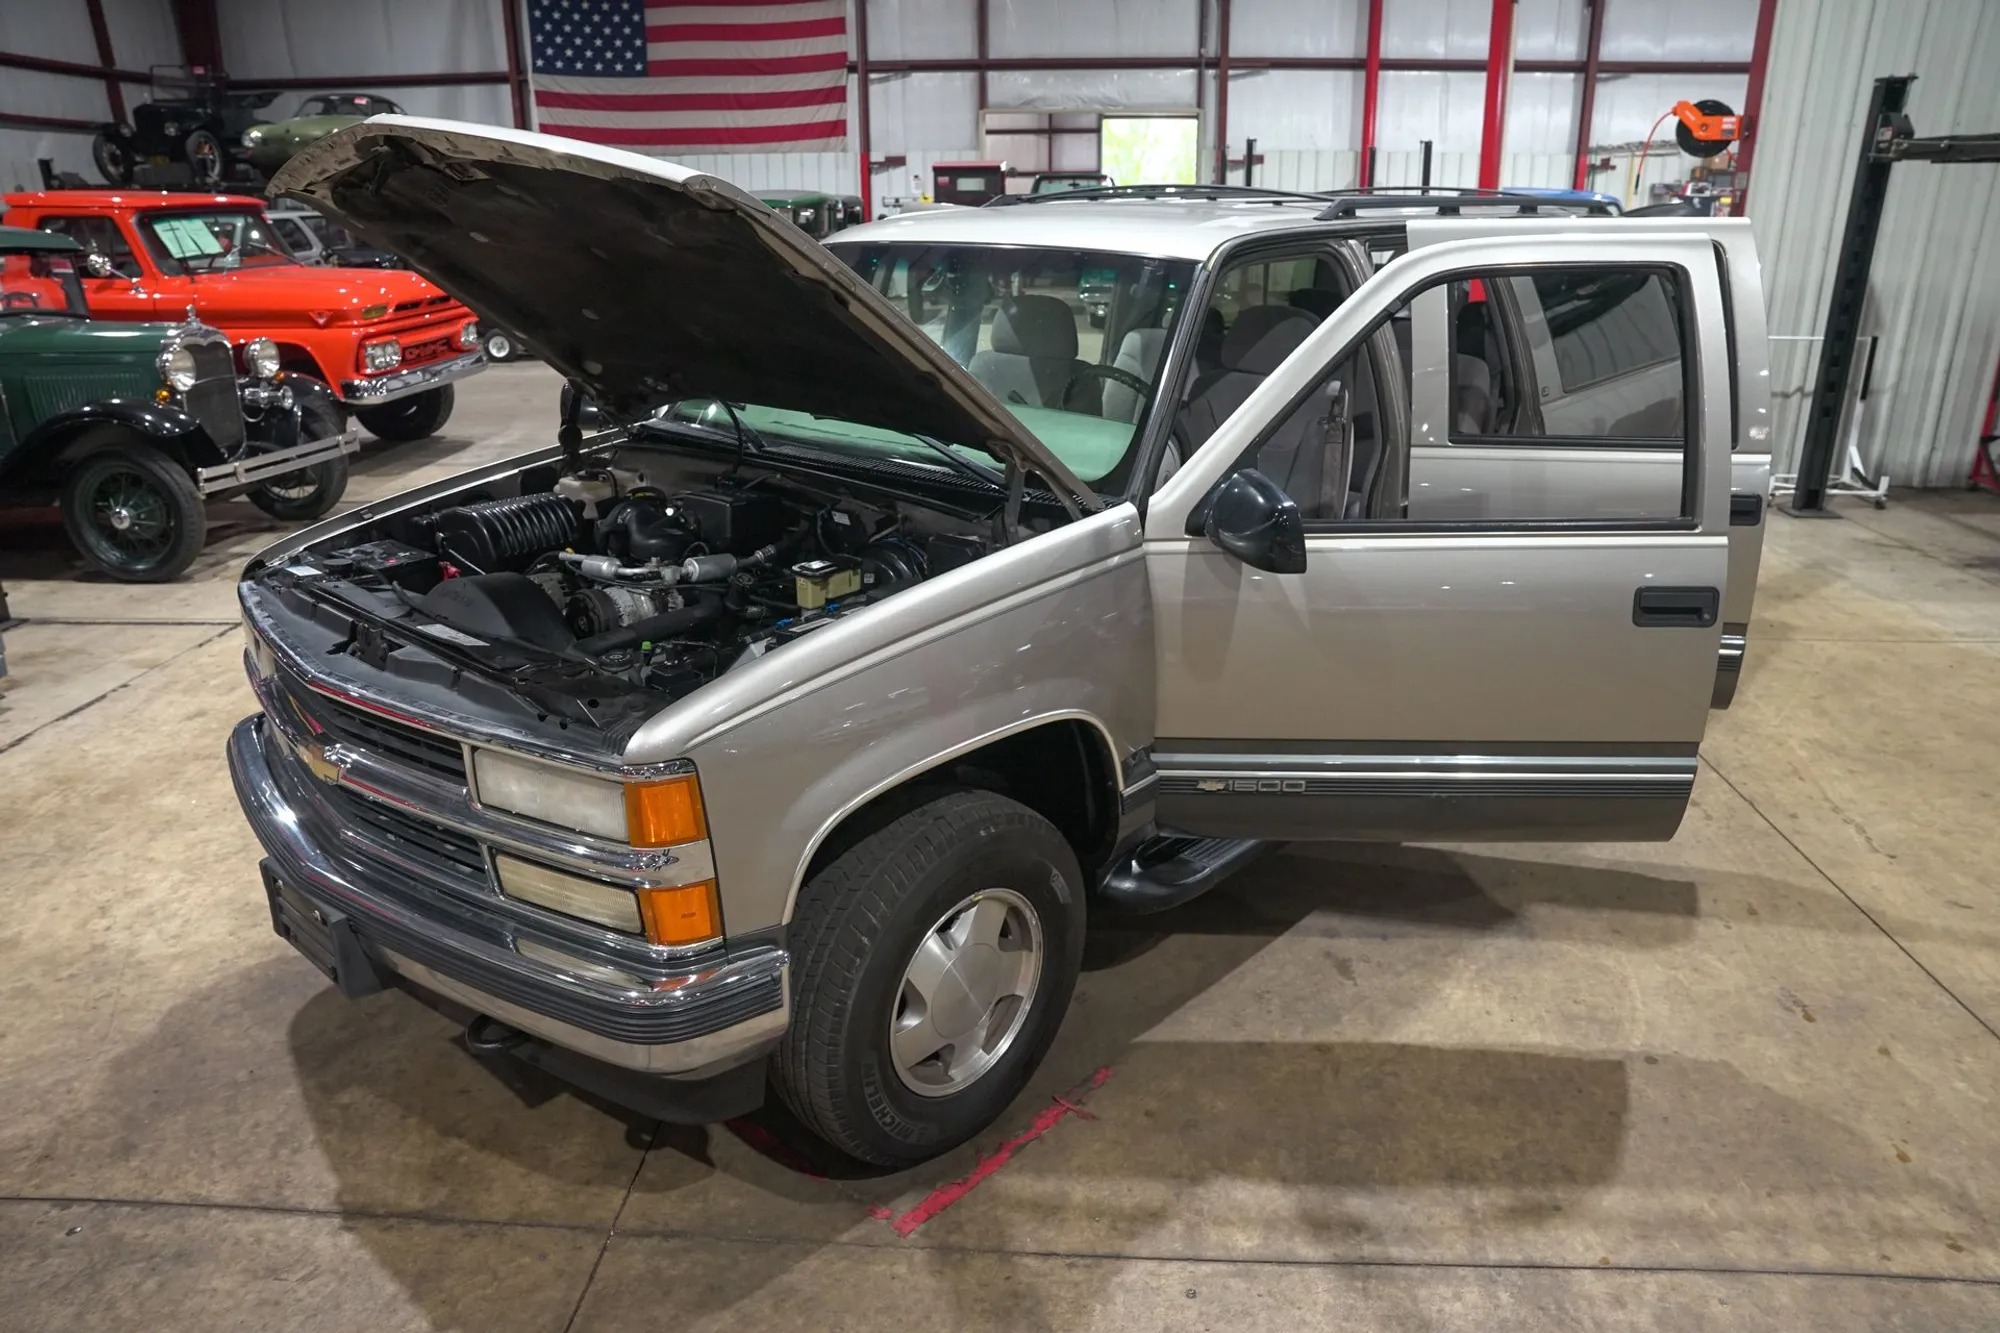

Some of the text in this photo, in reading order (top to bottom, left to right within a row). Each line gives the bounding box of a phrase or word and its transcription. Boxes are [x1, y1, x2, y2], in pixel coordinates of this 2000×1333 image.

[404, 338, 449, 360] GMC
[1228, 779, 1306, 793] 1500
[862, 1062, 916, 1141] MICHELIN
